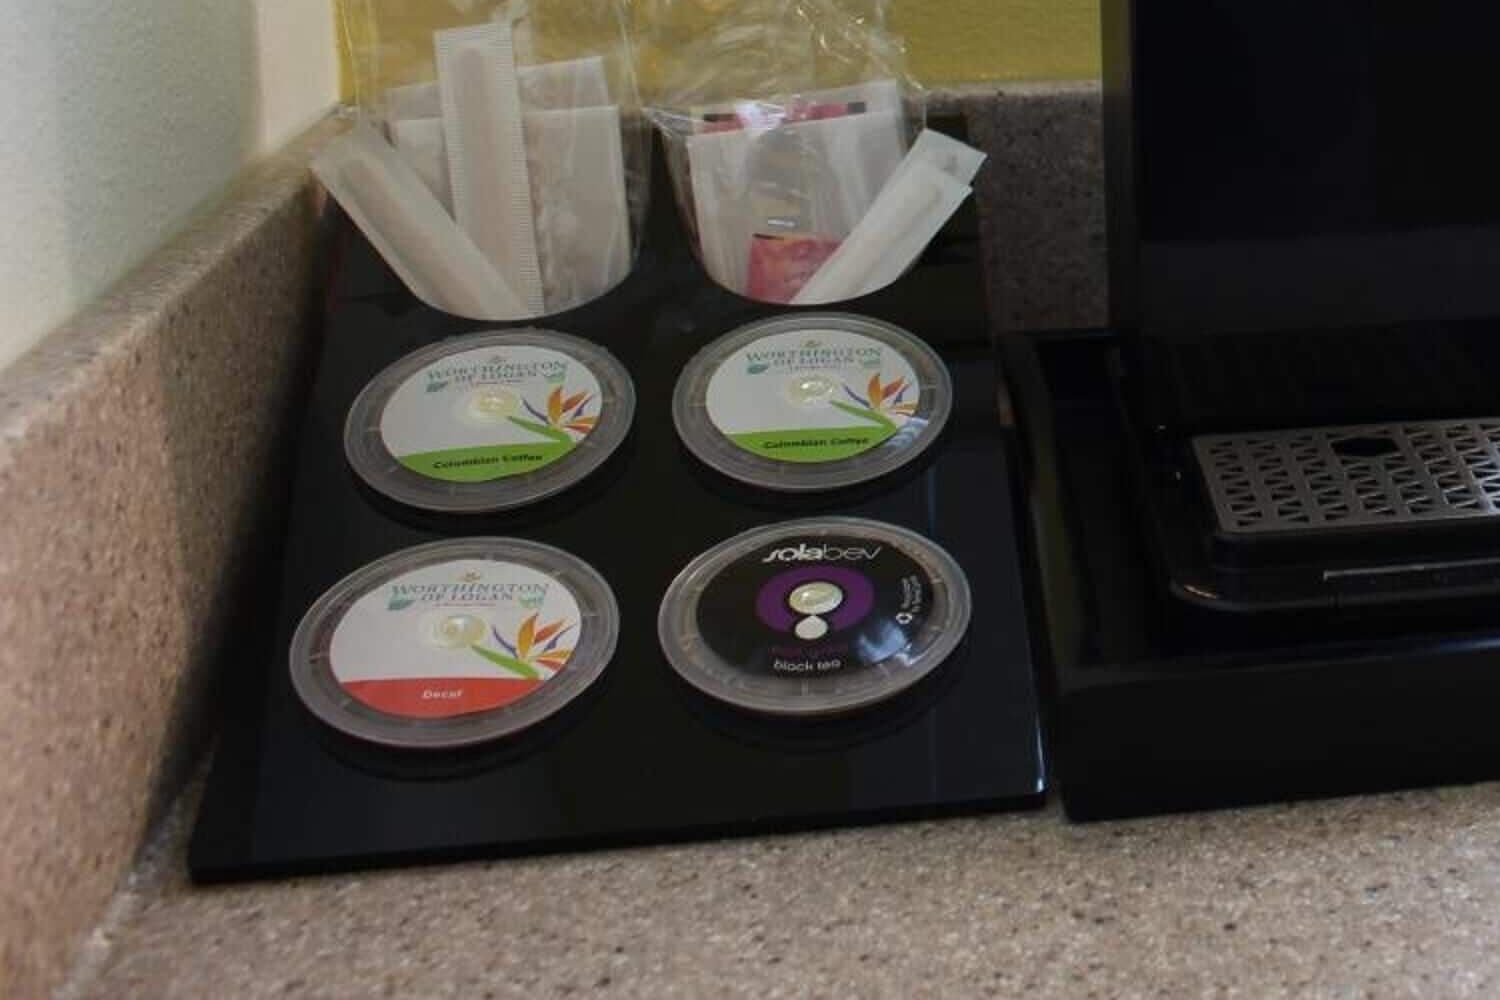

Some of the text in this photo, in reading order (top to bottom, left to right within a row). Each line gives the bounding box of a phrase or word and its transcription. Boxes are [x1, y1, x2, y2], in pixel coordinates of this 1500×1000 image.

[390, 583, 549, 597] WORTHINGTON
[421, 590, 513, 601] OF LOGAN
[773, 658, 842, 672] black tea
[422, 688, 464, 700] Decaf
